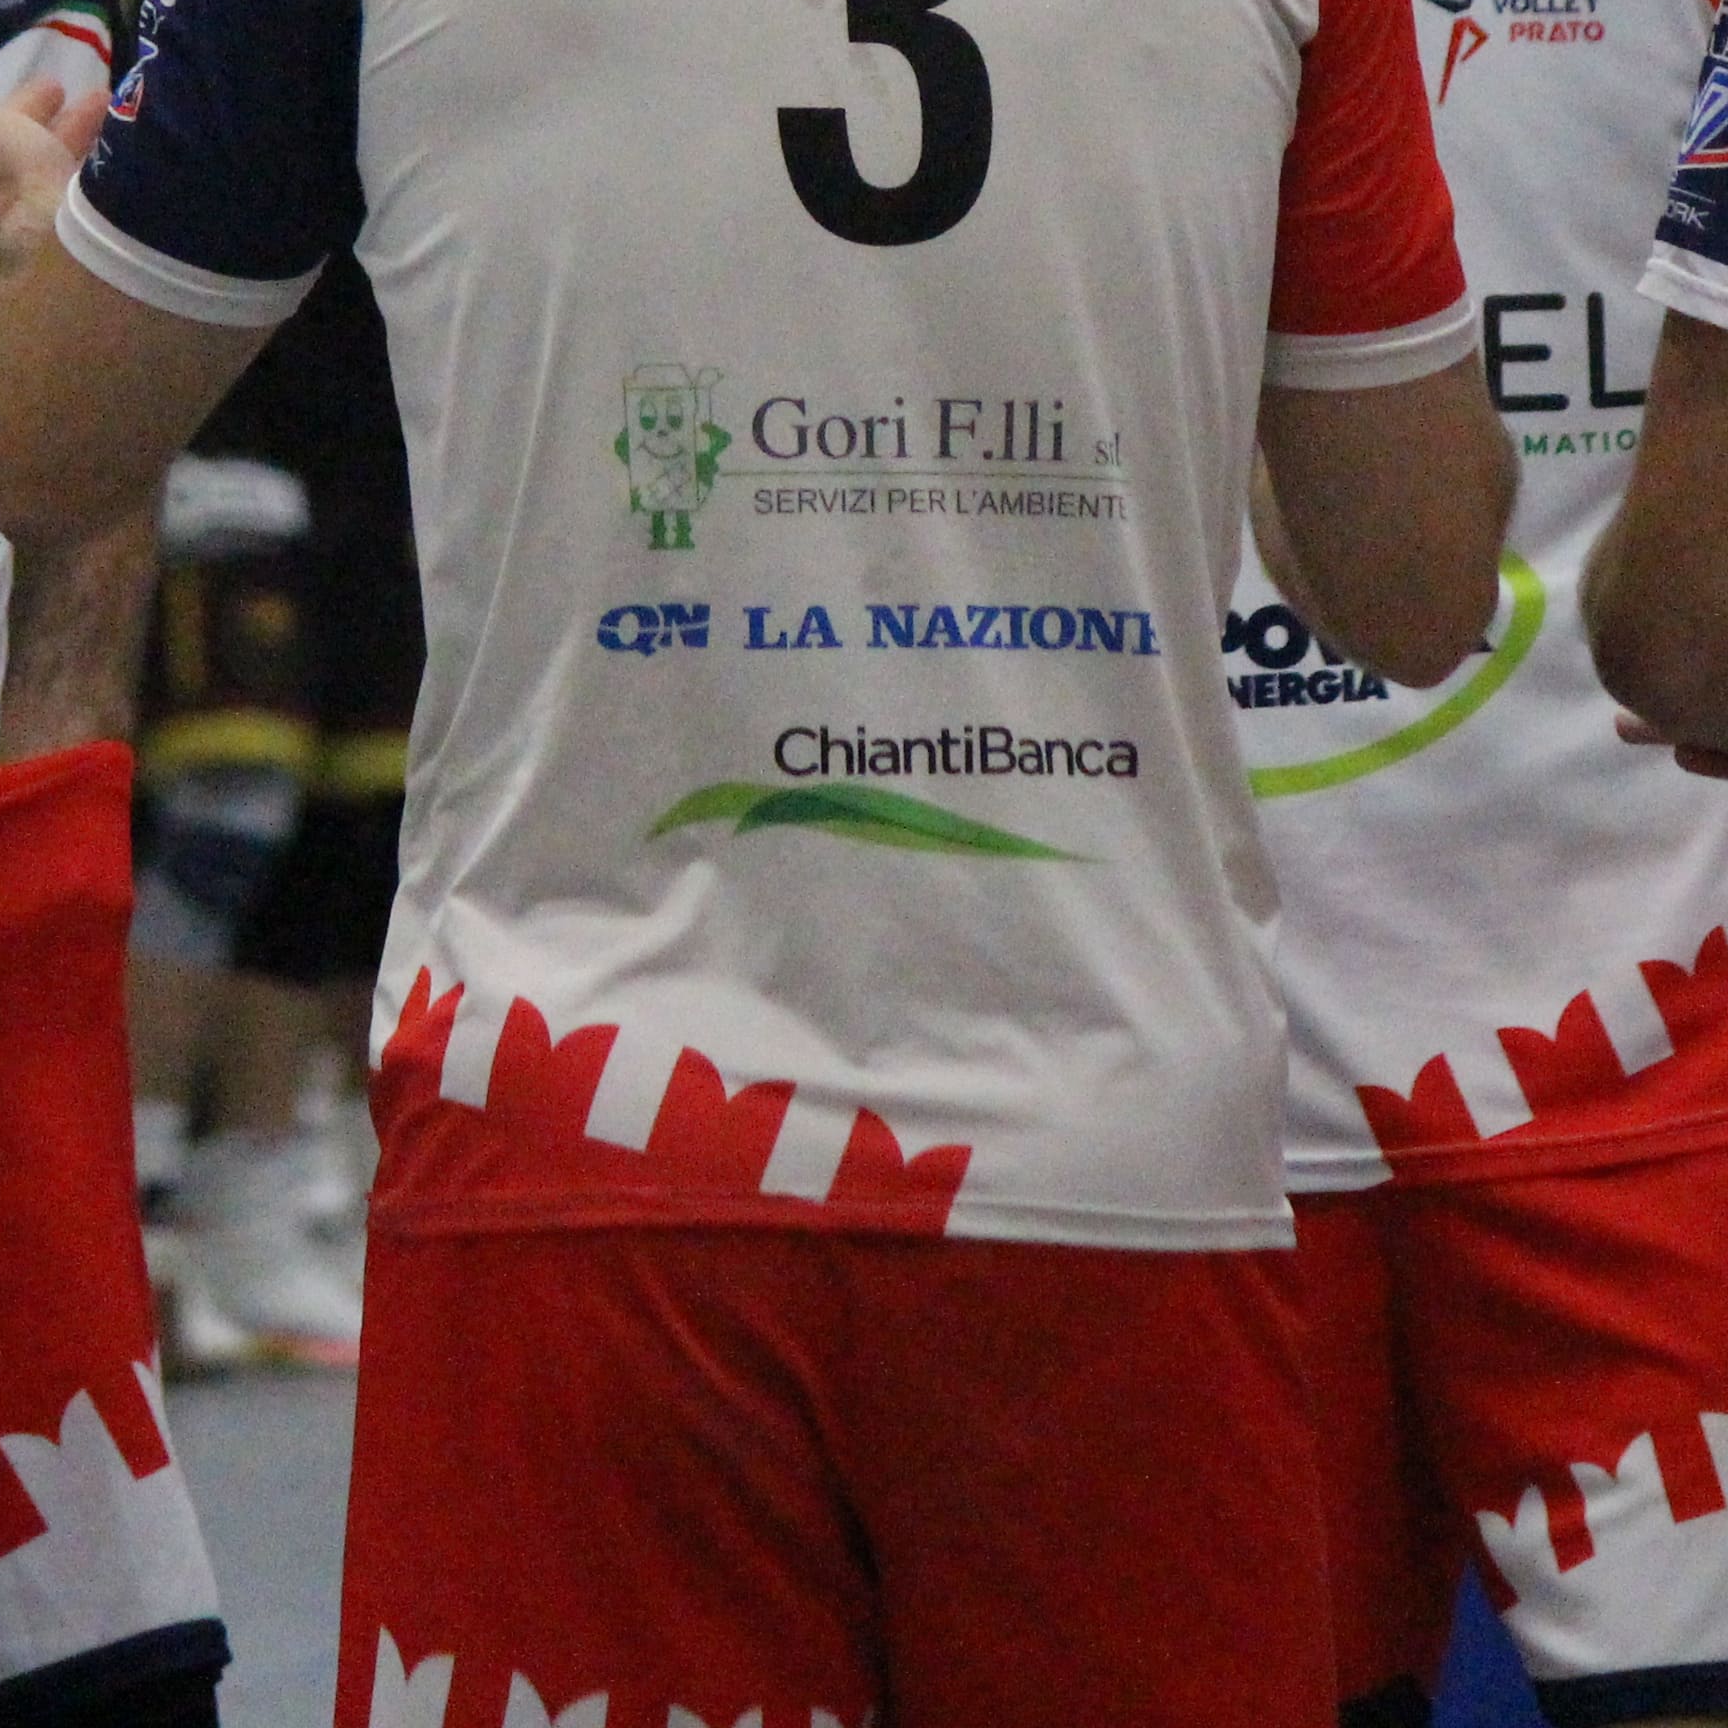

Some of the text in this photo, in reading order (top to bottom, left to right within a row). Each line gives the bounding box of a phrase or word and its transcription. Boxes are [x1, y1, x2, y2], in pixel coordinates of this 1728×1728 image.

[1508, 20, 1605, 44] PRATO
[751, 396, 913, 461] Gori
[935, 396, 1068, 463] F.lli
[753, 487, 877, 516] SERVIZI
[887, 488, 946, 515] PER
[596, 603, 711, 657] QN
[743, 604, 843, 650] LA
[866, 603, 1162, 656] NAZIONE
[1227, 668, 1390, 710] NERGIA
[774, 726, 1139, 778] ChiantiBanca
